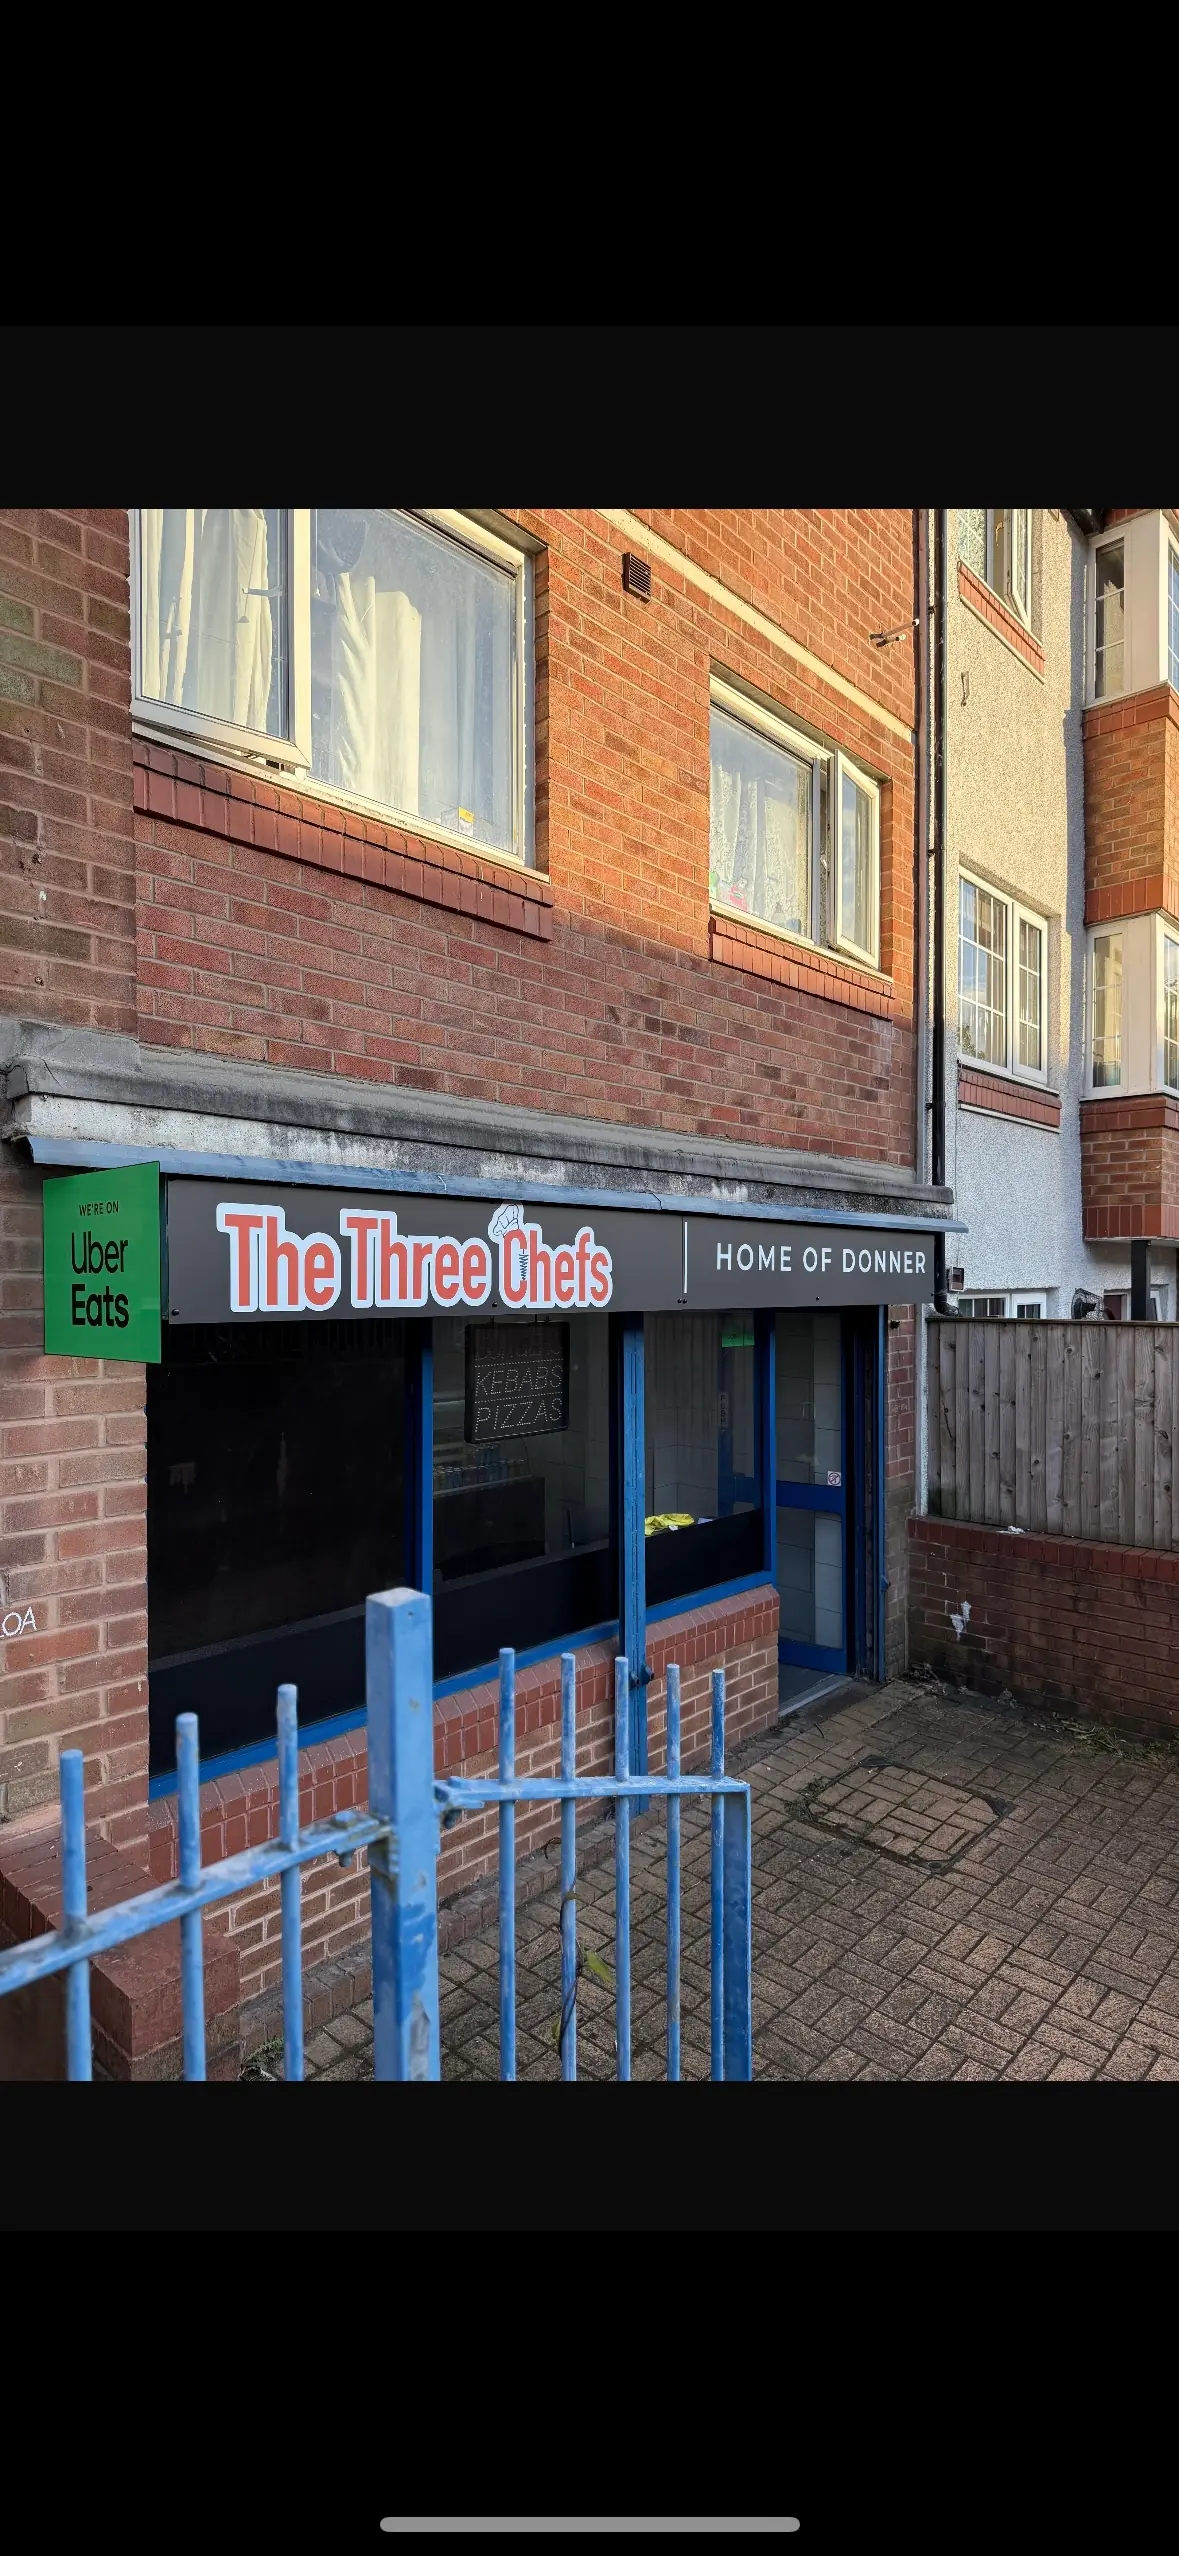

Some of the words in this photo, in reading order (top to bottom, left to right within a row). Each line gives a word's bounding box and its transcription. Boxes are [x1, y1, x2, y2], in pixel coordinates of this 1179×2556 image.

[79, 1202, 104, 1216] WE'RE
[106, 1200, 119, 1214] ON
[71, 1231, 129, 1274] Uber
[224, 1213, 335, 1306] The
[346, 1216, 487, 1300] Three
[503, 1228, 609, 1303] Chefs
[716, 1242, 792, 1272] HOME
[802, 1246, 832, 1273] OF
[842, 1249, 926, 1274] DONNER
[71, 1283, 130, 1328] Eats
[475, 1364, 564, 1396] KEBABS
[475, 1397, 563, 1433] PIZZAS
[0, 1606, 38, 1637] OA
